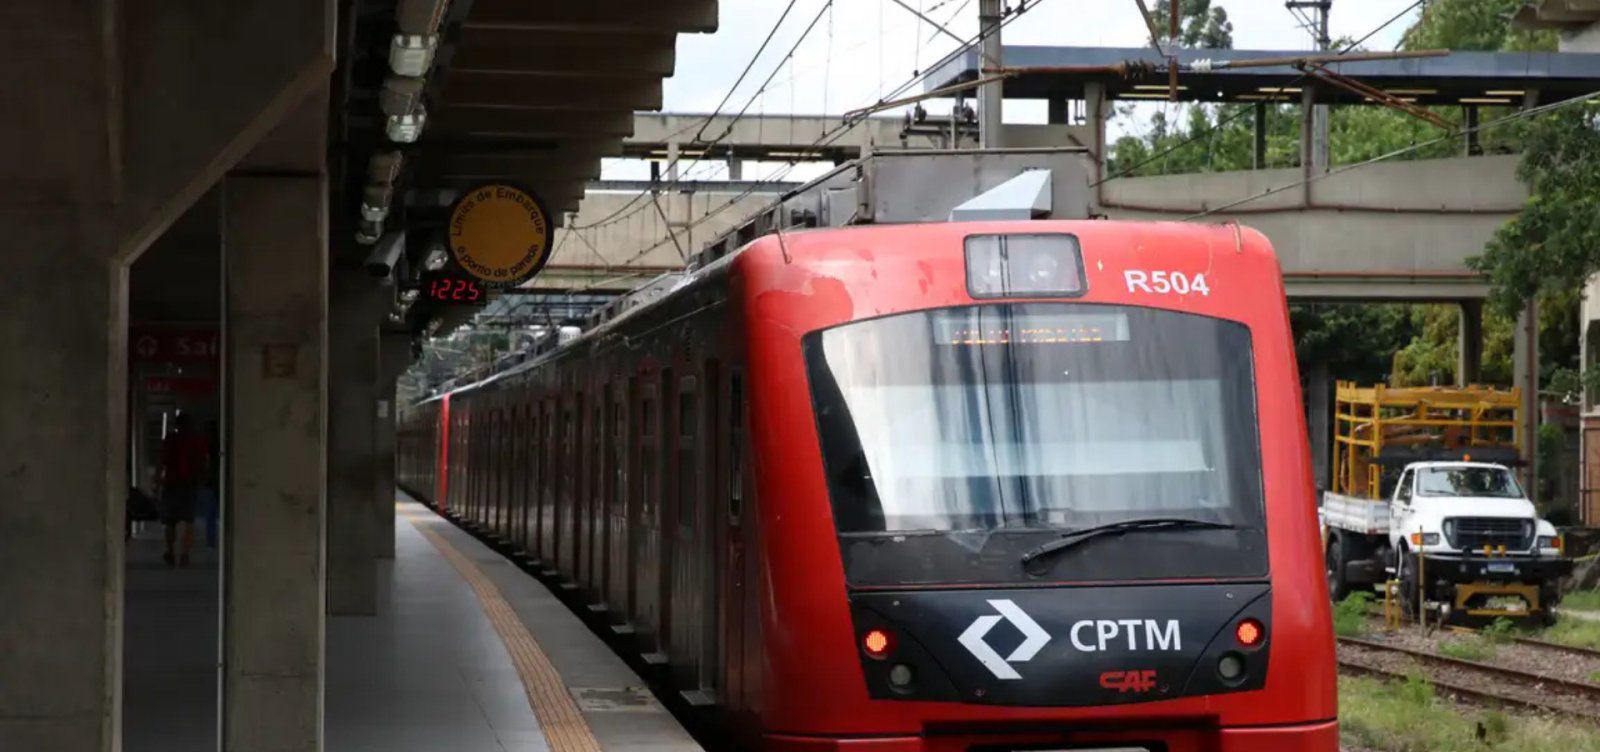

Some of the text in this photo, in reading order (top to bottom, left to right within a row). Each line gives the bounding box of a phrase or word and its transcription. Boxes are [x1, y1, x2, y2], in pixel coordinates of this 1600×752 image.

[477, 190, 492, 202] de
[496, 187, 544, 235] Embarque
[461, 252, 492, 276] ponto
[494, 267, 508, 277] de
[510, 244, 539, 275] parada
[1123, 269, 1210, 296] R504
[1070, 619, 1181, 652] CPTM
[1099, 670, 1158, 693] CAF
